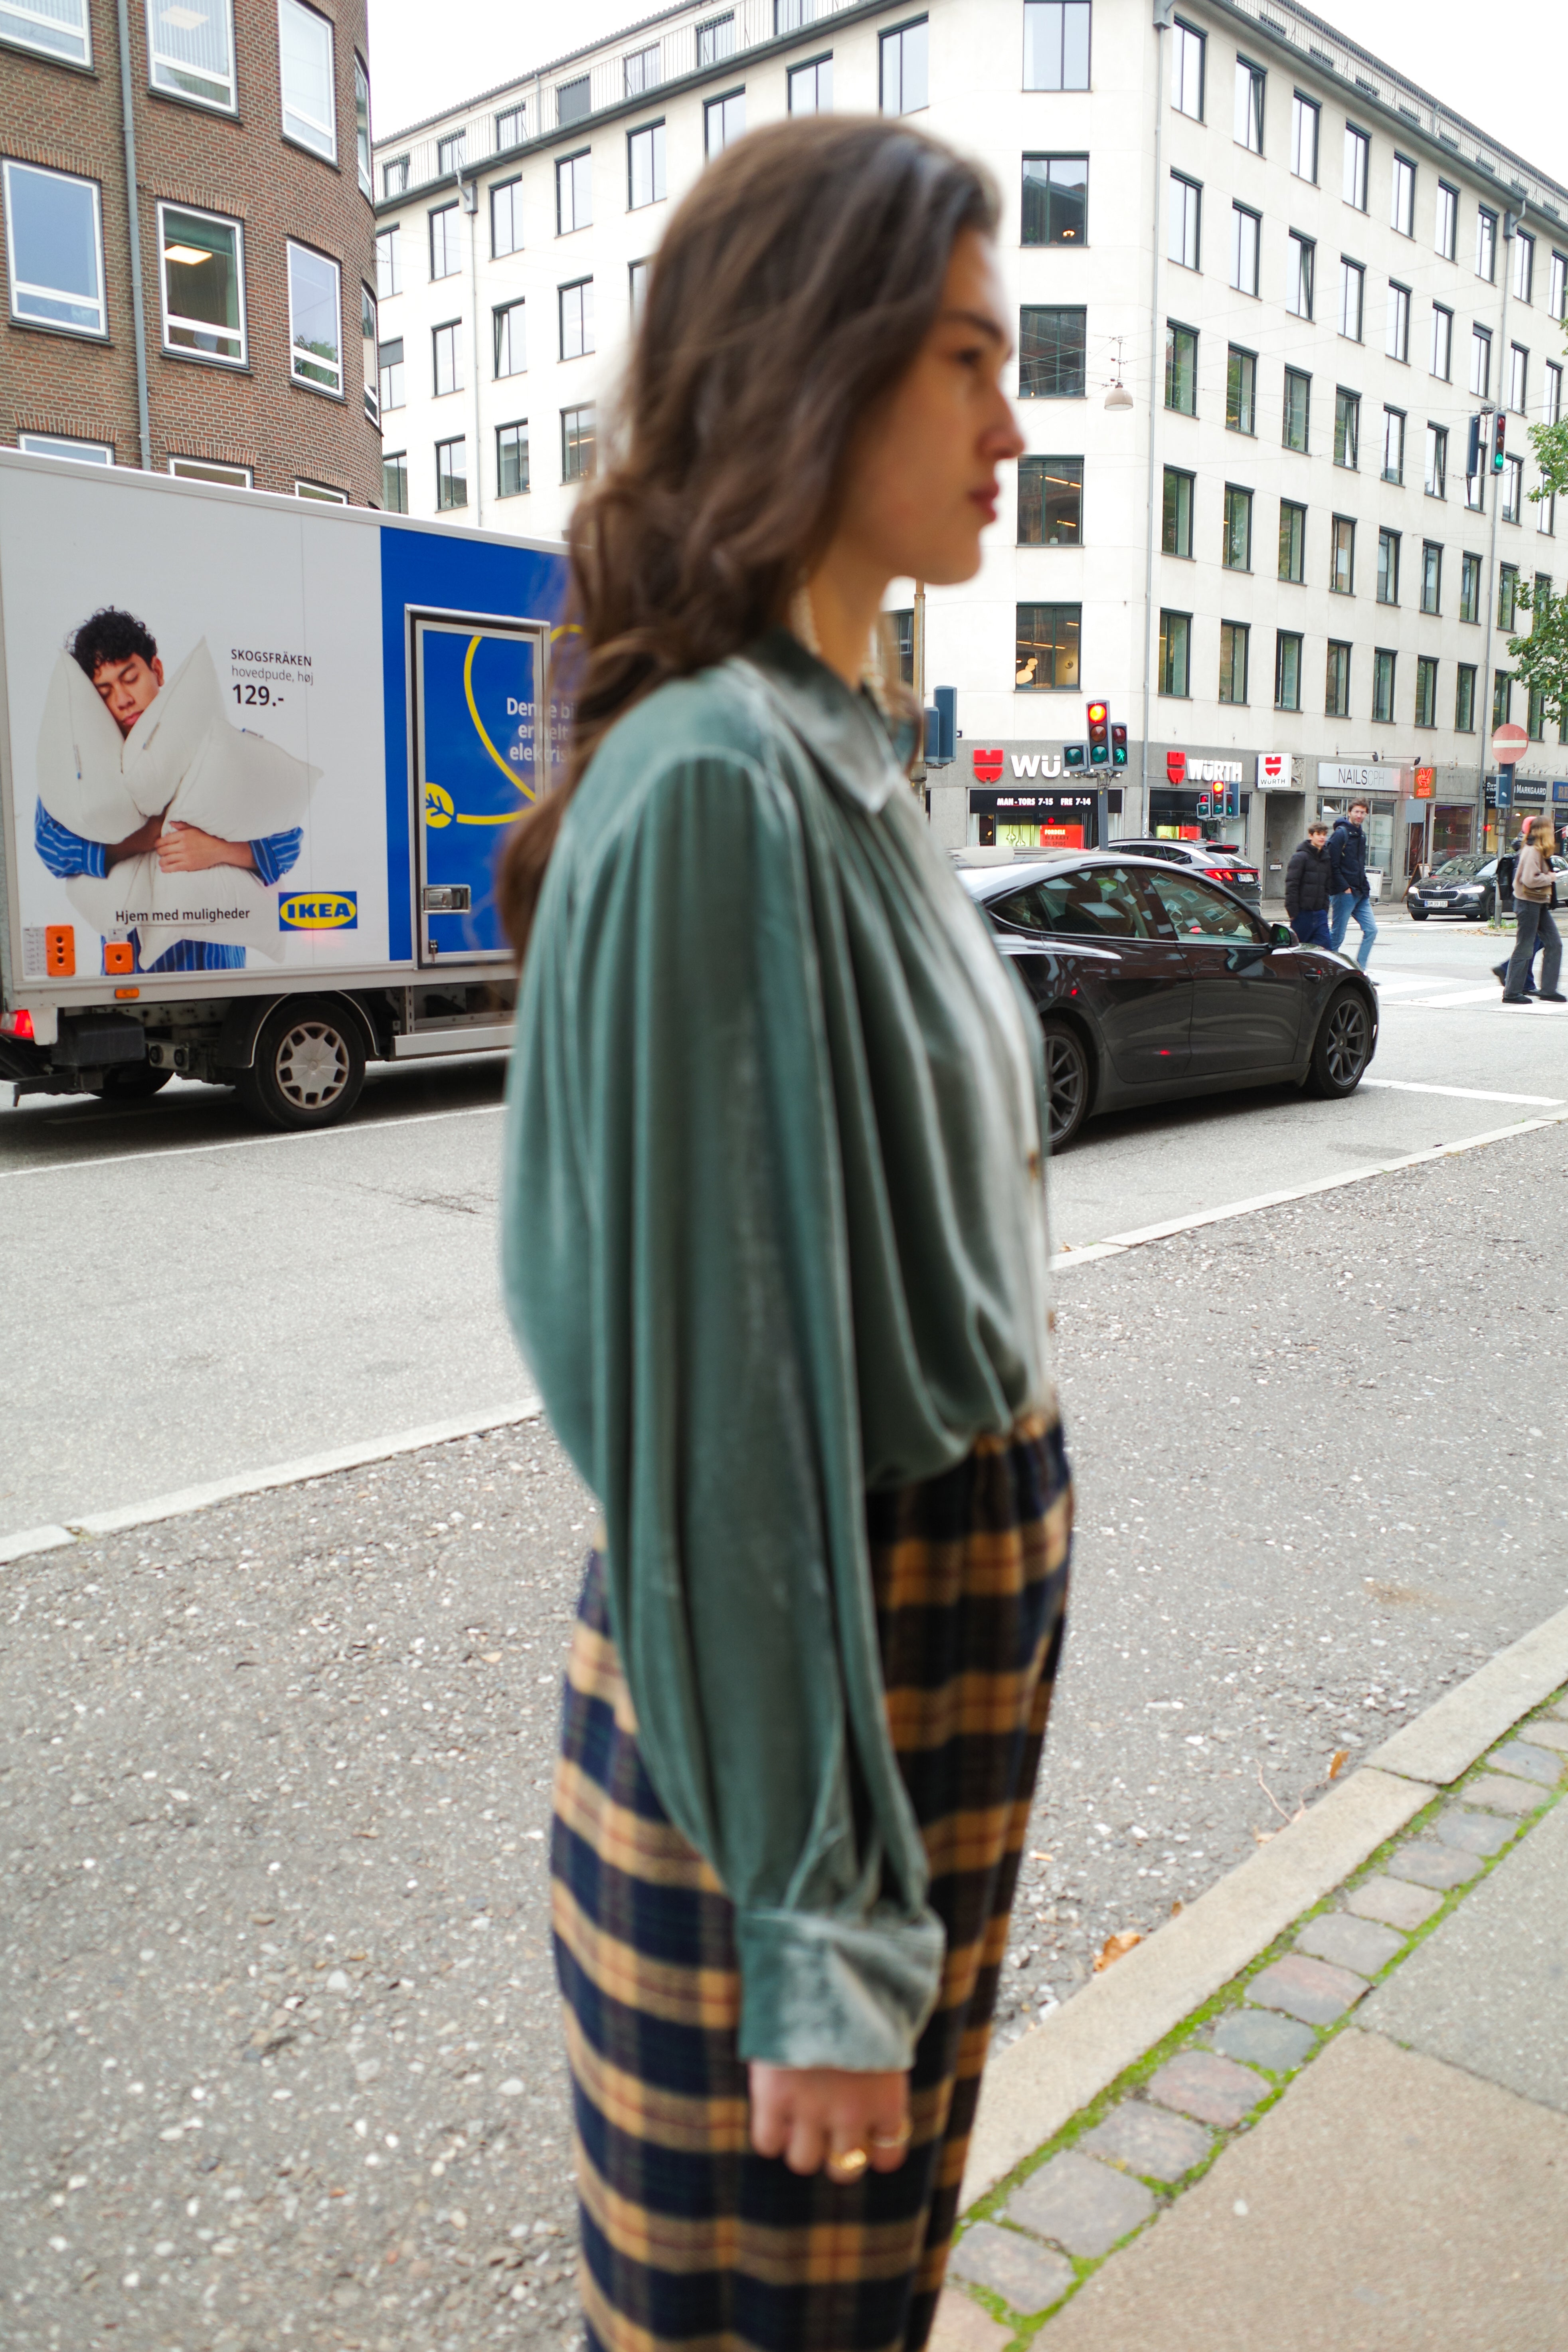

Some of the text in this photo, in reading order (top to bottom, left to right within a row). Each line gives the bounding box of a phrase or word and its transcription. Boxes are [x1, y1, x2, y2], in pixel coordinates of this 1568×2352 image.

[231, 649, 312, 666] SKOGSFRÄKEN
[232, 665, 314, 686] hovedpude, høj
[233, 684, 284, 706] 129.-
[518, 724, 534, 738] er
[1186, 759, 1242, 781] WÜRTH
[1517, 785, 1546, 795] MARKGAARD
[116, 908, 250, 924] Hjem med muligheder
[288, 903, 350, 918] IKEA
